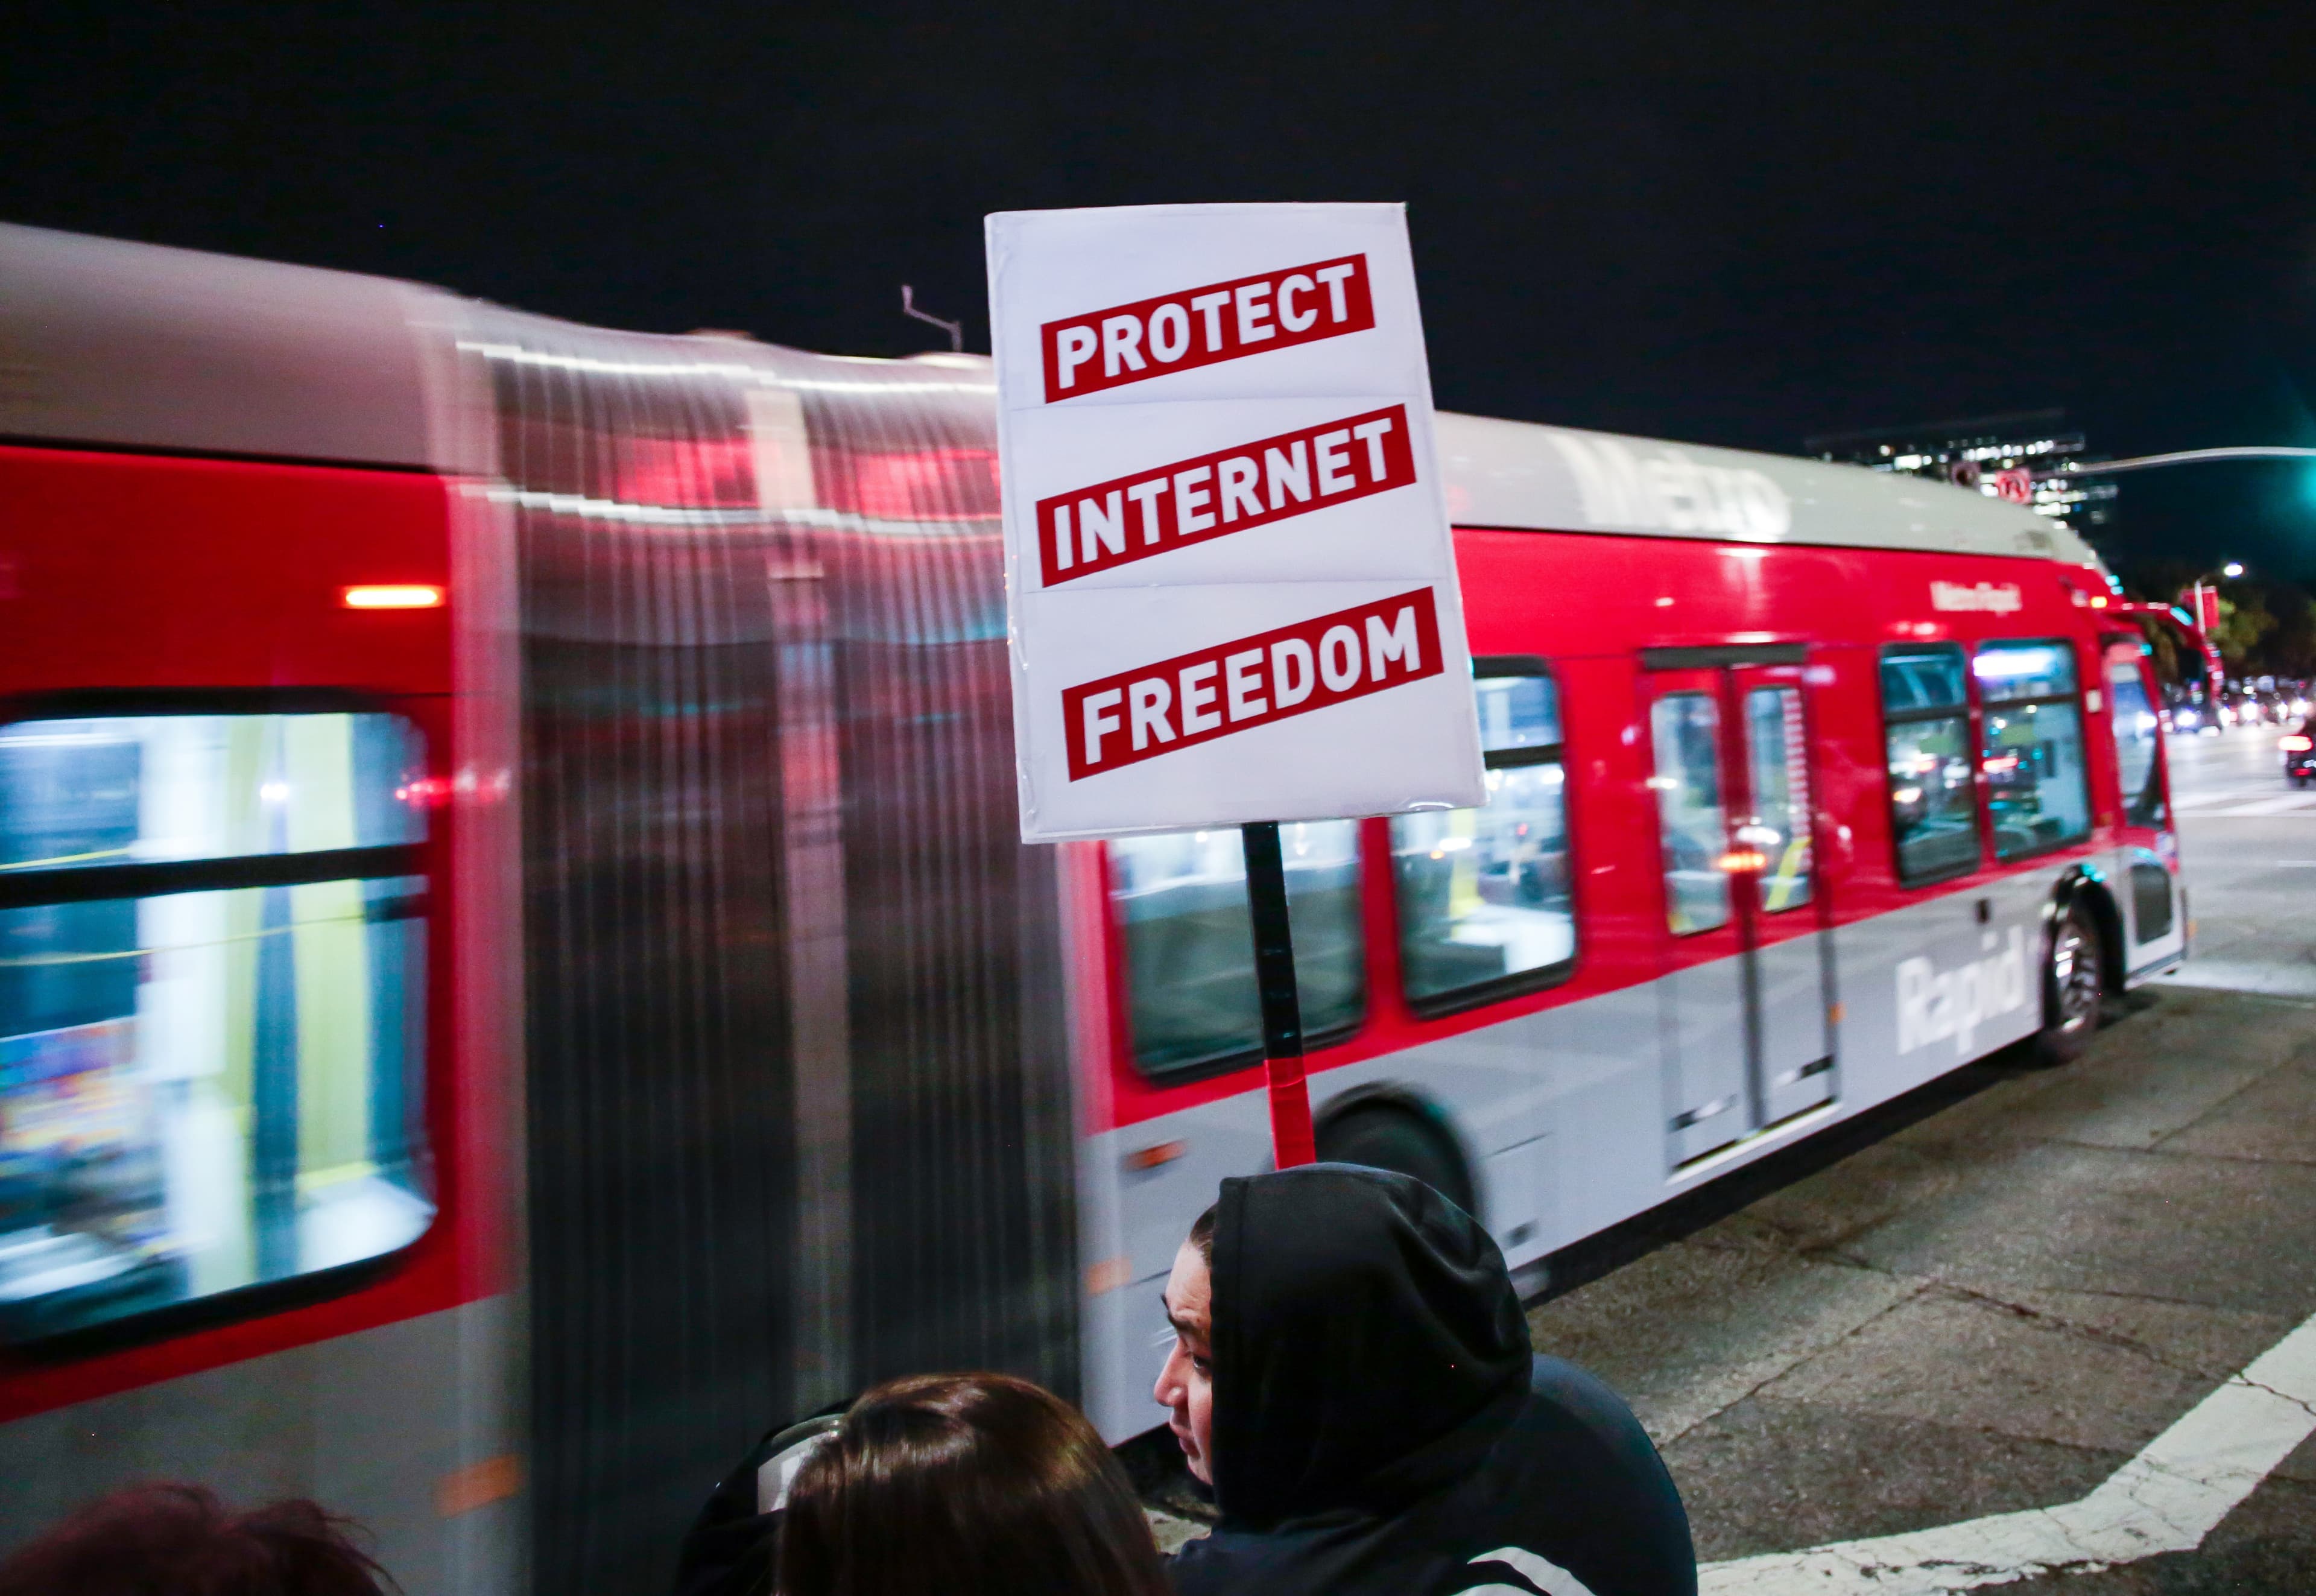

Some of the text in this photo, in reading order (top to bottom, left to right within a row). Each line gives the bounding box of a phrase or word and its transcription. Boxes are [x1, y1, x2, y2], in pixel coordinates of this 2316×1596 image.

[1056, 263, 1355, 390] PROTECT
[1054, 417, 1393, 571] INTERNET
[1083, 606, 1421, 765] FREEDOM
[1897, 925, 2025, 1055] Rapid
